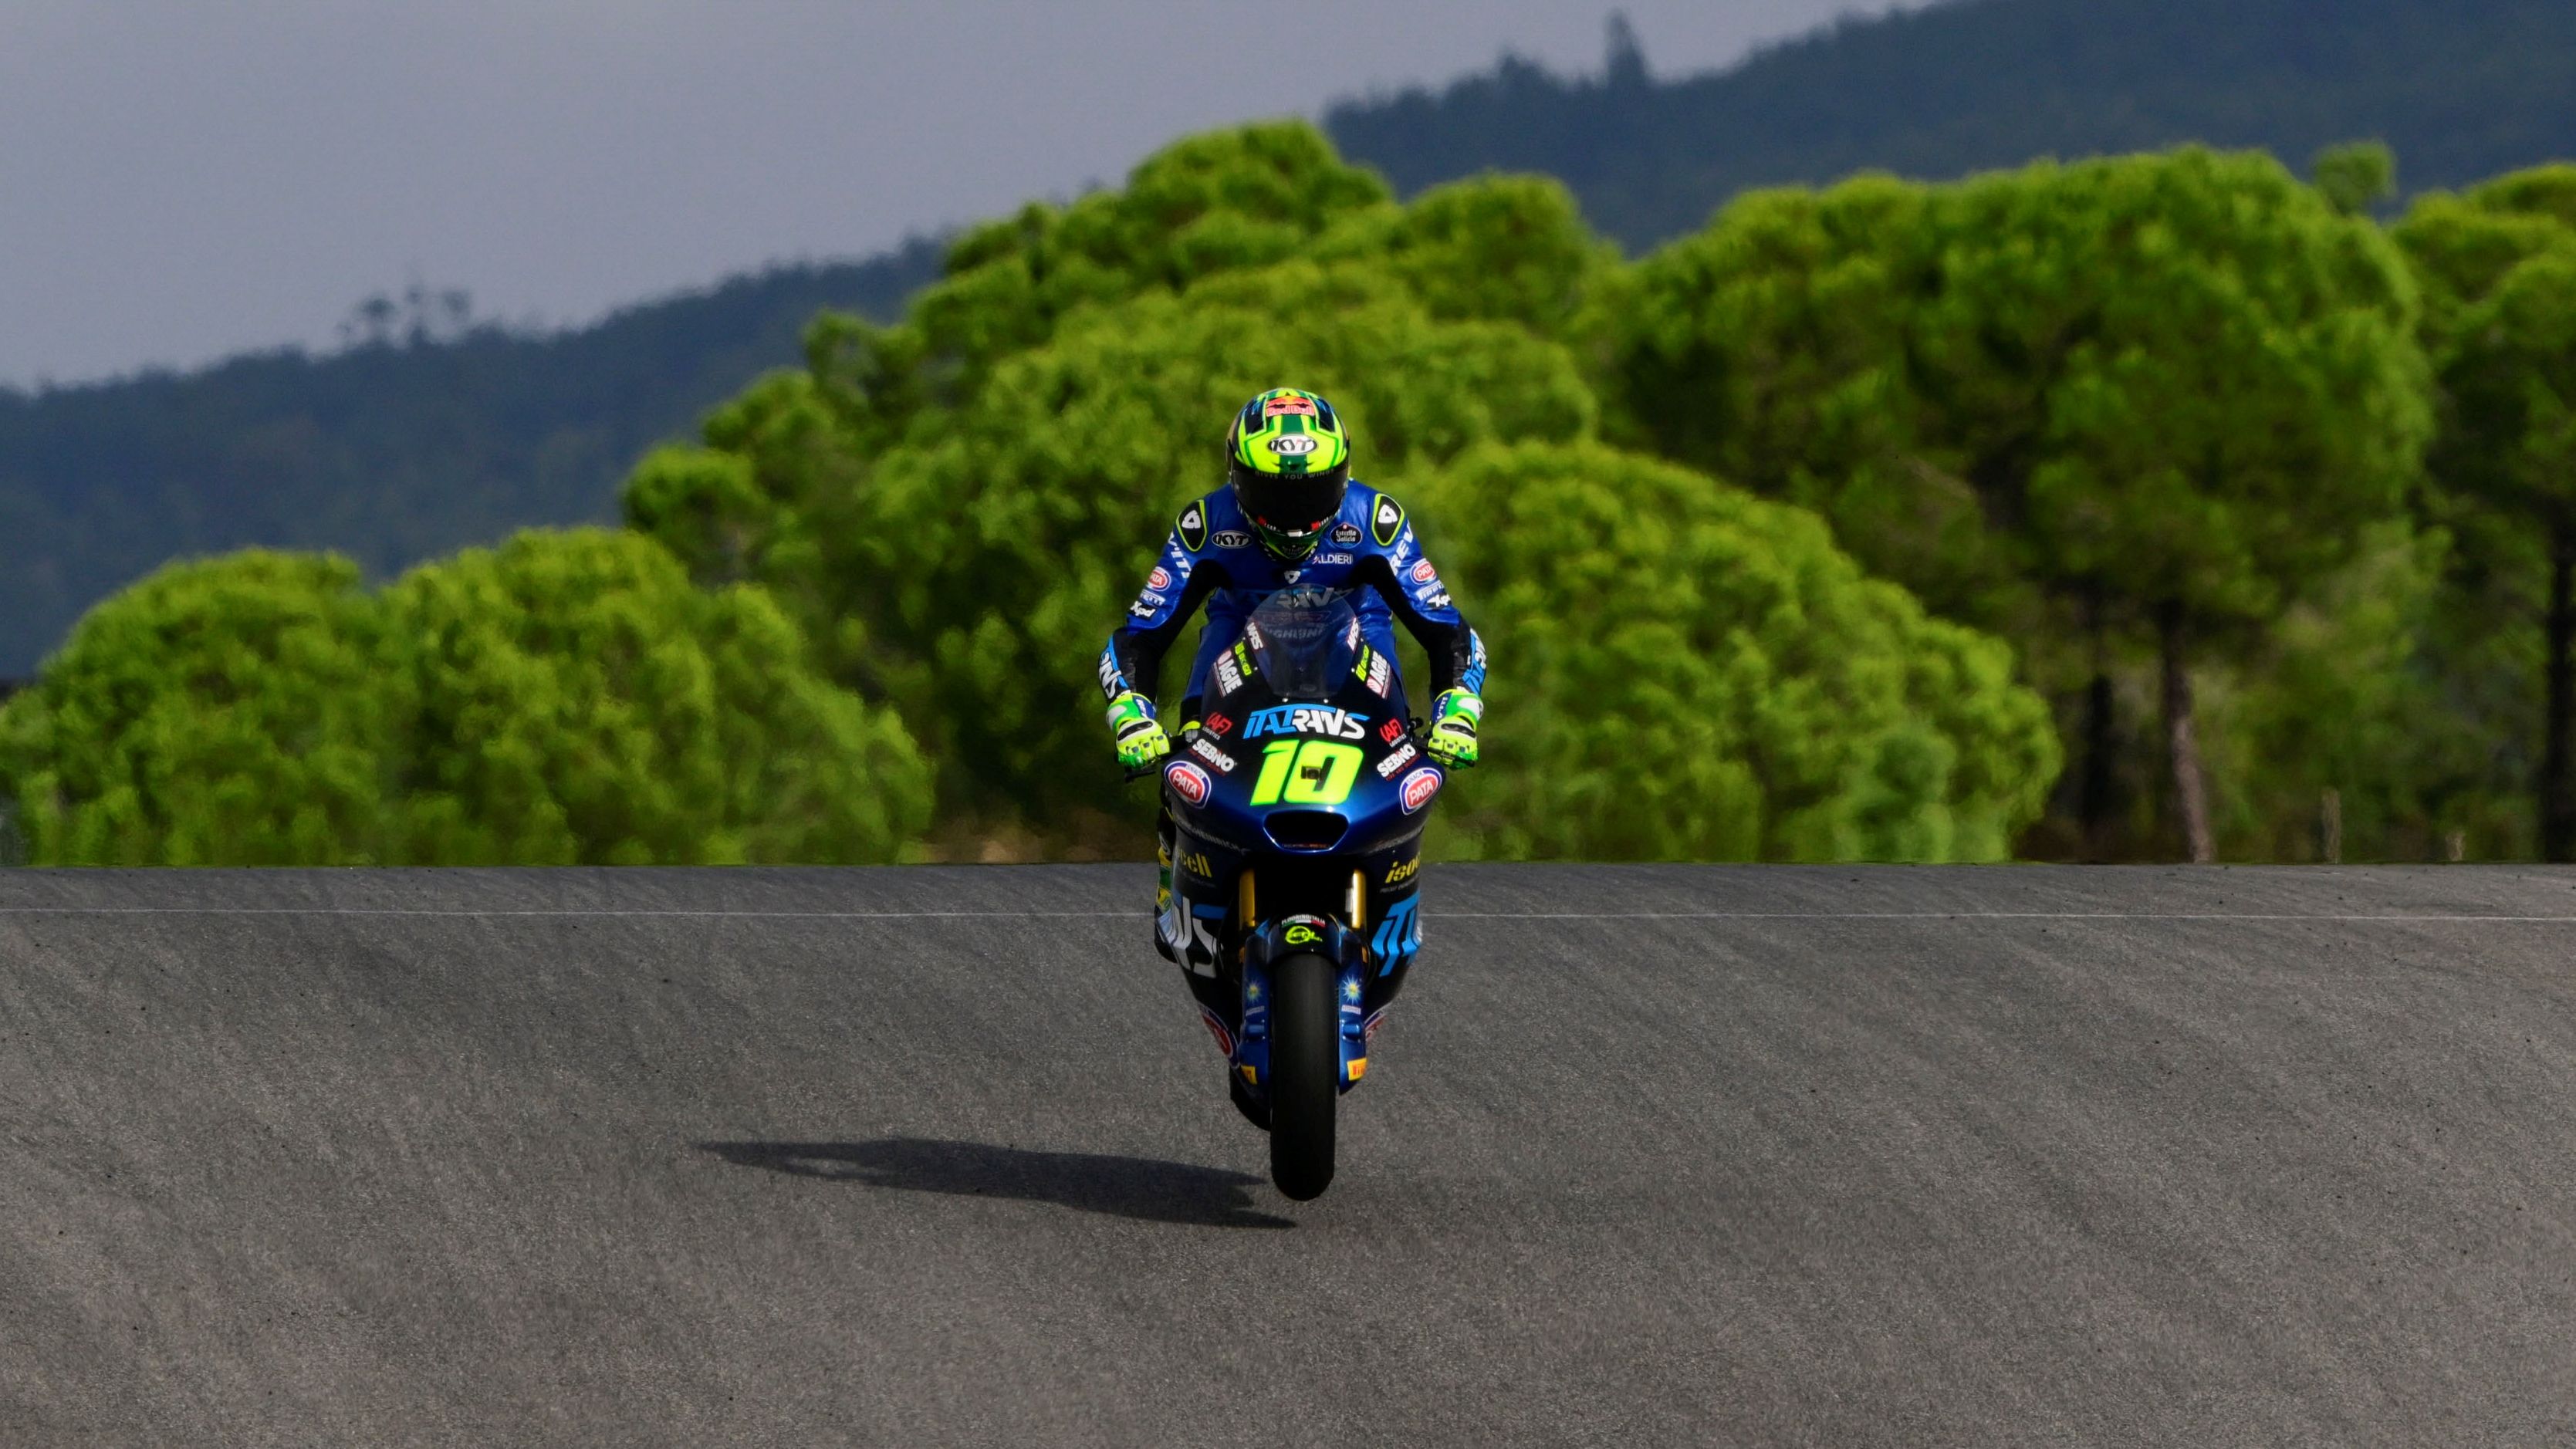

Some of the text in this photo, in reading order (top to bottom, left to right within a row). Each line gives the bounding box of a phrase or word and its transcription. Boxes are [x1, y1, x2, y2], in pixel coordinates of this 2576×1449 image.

[1273, 439, 1311, 451] KYT
[1216, 534, 1249, 545] KYT
[1243, 704, 1370, 740] ITALTRANS
[1173, 771, 1199, 798] PATA
[1250, 739, 1364, 806] 10
[1408, 780, 1433, 805] PATA
